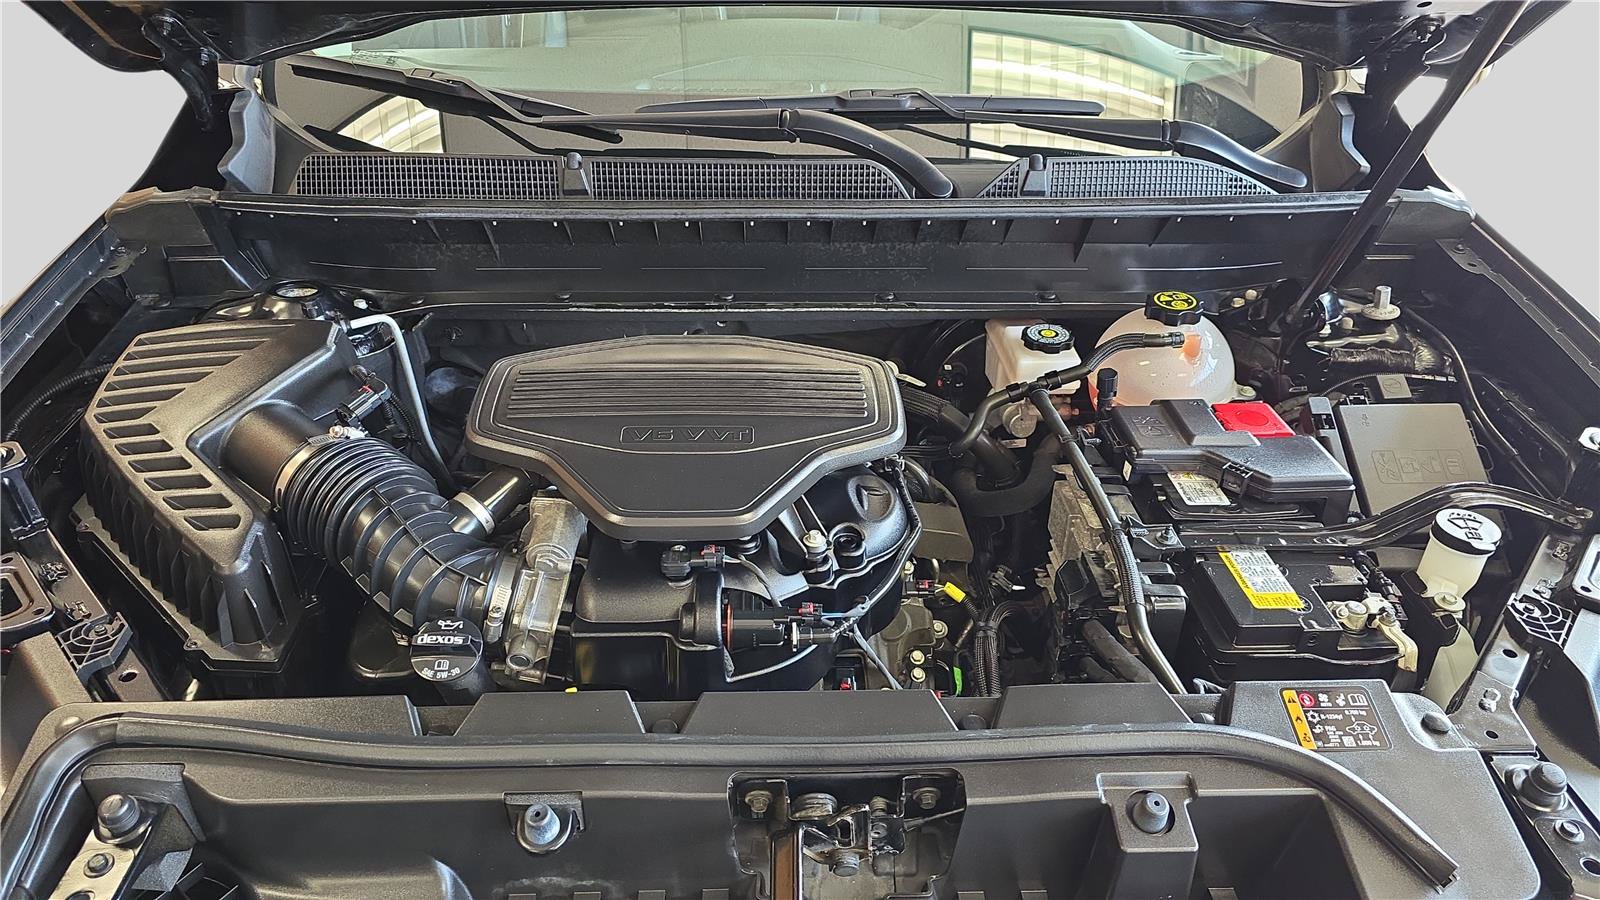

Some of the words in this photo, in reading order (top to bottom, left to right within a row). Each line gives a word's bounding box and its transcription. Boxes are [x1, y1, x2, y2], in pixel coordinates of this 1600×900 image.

[628, 429, 674, 441] V6
[681, 429, 749, 441] VVT
[416, 633, 466, 645] dexos
[421, 667, 435, 678] SAE
[436, 667, 460, 679] 5W-30
